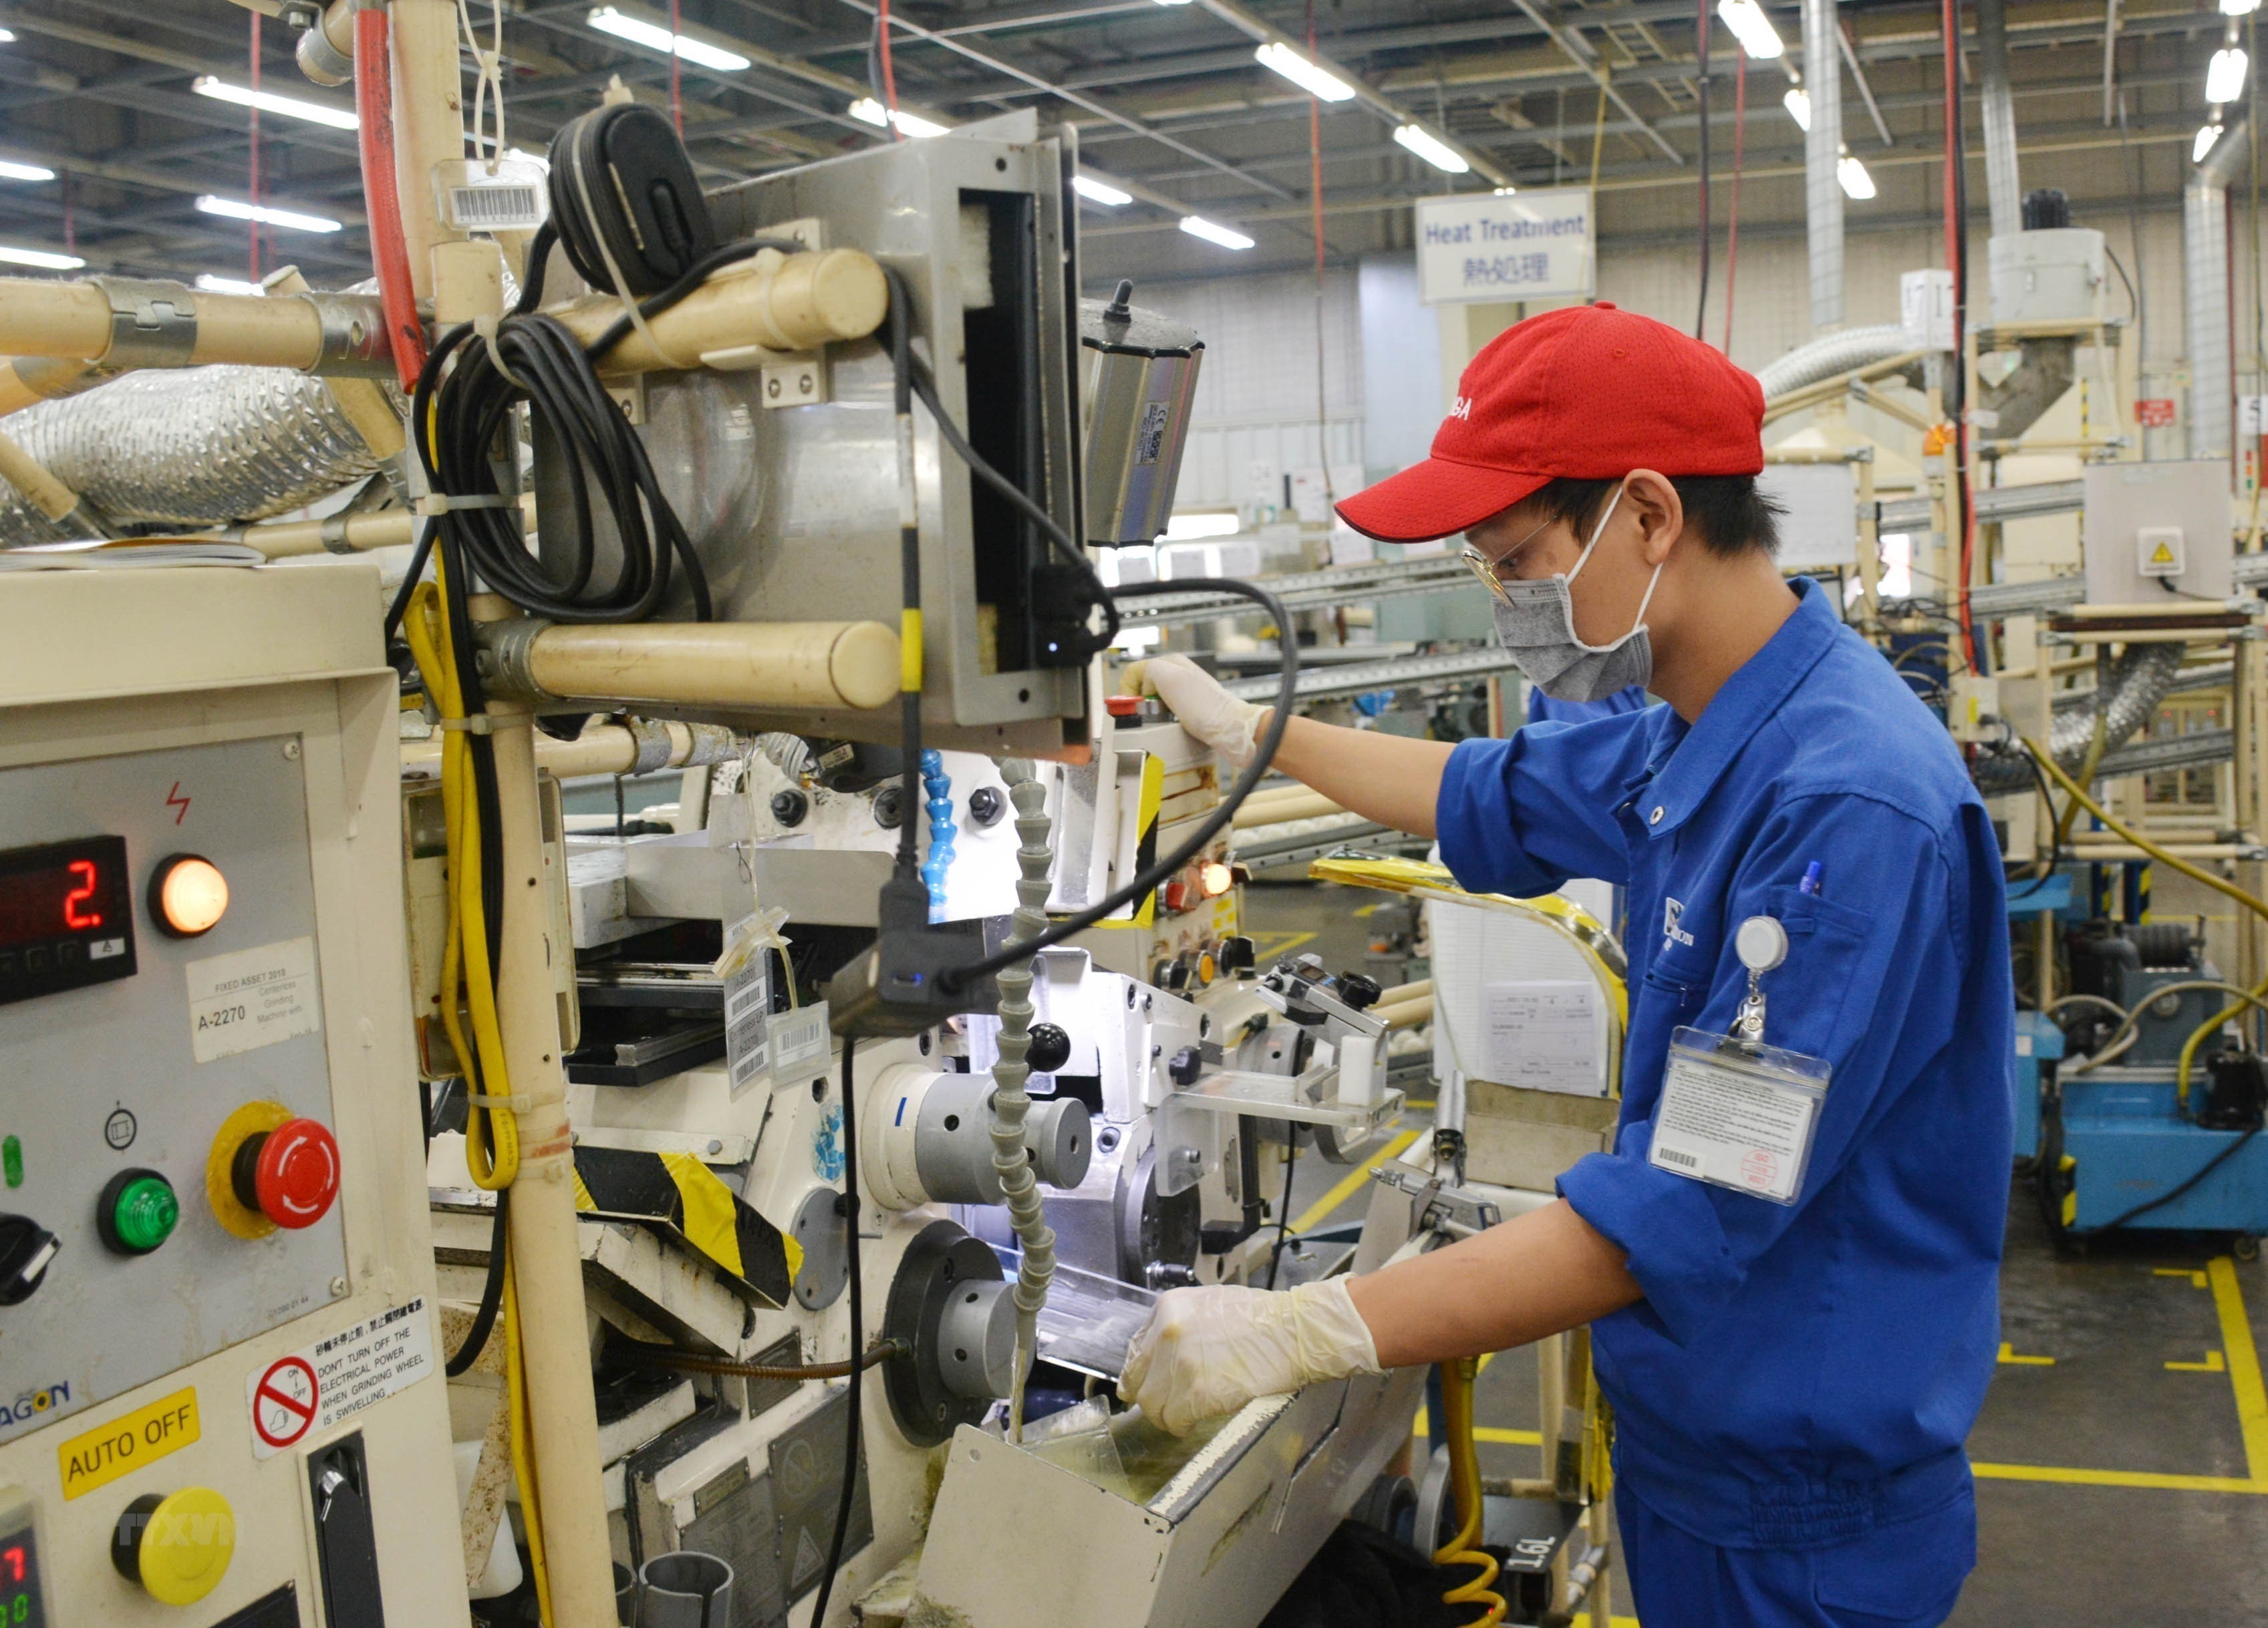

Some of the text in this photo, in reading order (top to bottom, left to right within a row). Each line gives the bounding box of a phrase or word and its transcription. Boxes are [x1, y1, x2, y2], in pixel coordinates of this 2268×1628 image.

[1425, 215, 1584, 245] Heat Treatment
[215, 980, 240, 993] FIXED
[241, 973, 267, 986] ASSET
[198, 1005, 245, 1031] A-2270
[347, 1347, 370, 1364] TURN
[374, 1337, 391, 1352] OFF
[394, 1327, 411, 1342] THE
[288, 1367, 299, 1379] ON
[320, 1347, 404, 1395] ELECTRICAL POWER
[321, 1354, 424, 1409] WHEN GRINDING WHEEL
[293, 1387, 307, 1400] OFF
[323, 1388, 386, 1426] IS SWIVELLING
[68, 1404, 191, 1483] AUTO OFF
[1507, 1536, 1556, 1569] 1.6L
